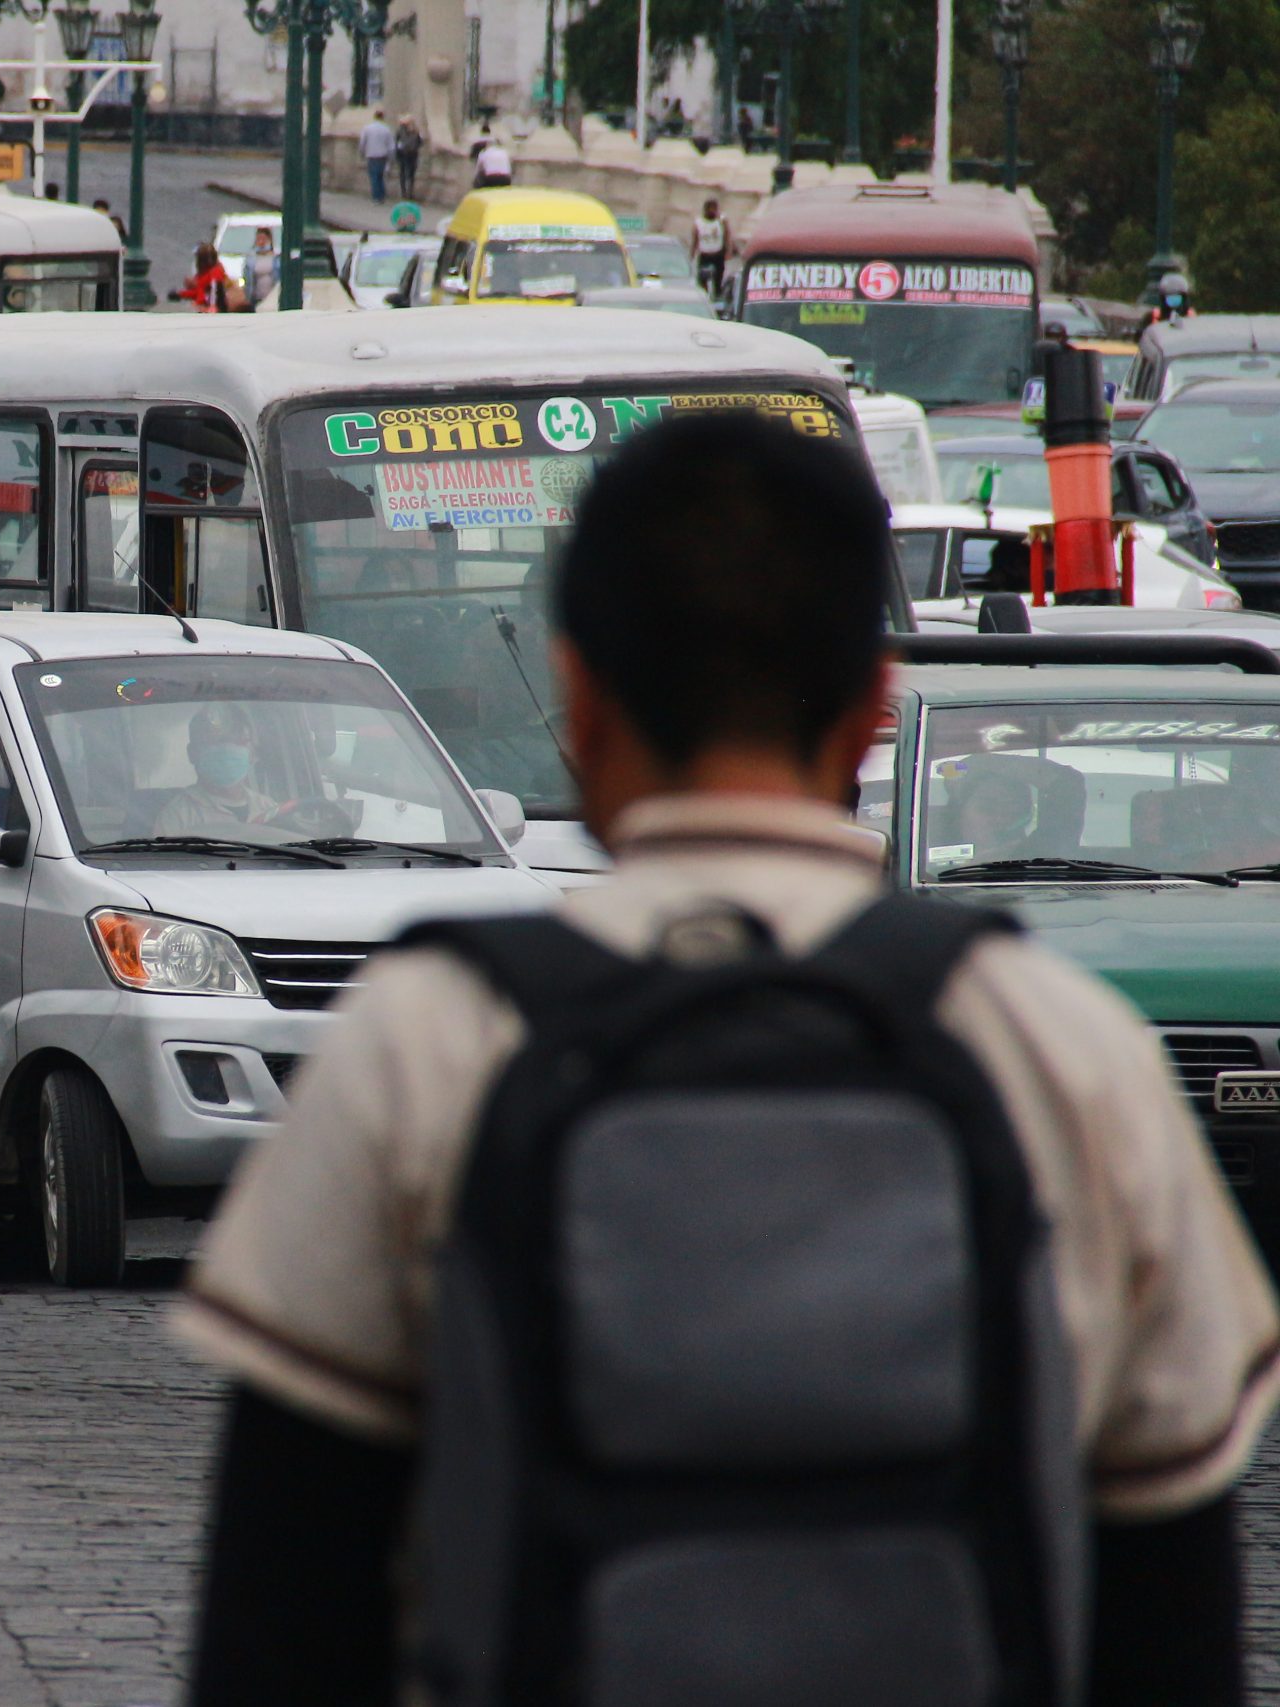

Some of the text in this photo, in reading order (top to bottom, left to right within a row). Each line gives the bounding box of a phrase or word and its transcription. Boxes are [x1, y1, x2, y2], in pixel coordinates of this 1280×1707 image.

[747, 264, 859, 290] KENNEDY
[865, 267, 891, 296] 5
[903, 266, 947, 291] ALTO
[949, 267, 1033, 295] LIBERTAD
[672, 394, 824, 409] EMPRESARIAL
[379, 404, 517, 425] CONSORCIO
[544, 403, 591, 442] C-2
[324, 411, 523, 457] Cono
[383, 459, 535, 494] BUSTAMANTE
[540, 475, 591, 488] CIMA
[391, 512, 420, 529] AV.
[426, 508, 533, 527] EJERCITO
[1058, 721, 1280, 741] NISSA
